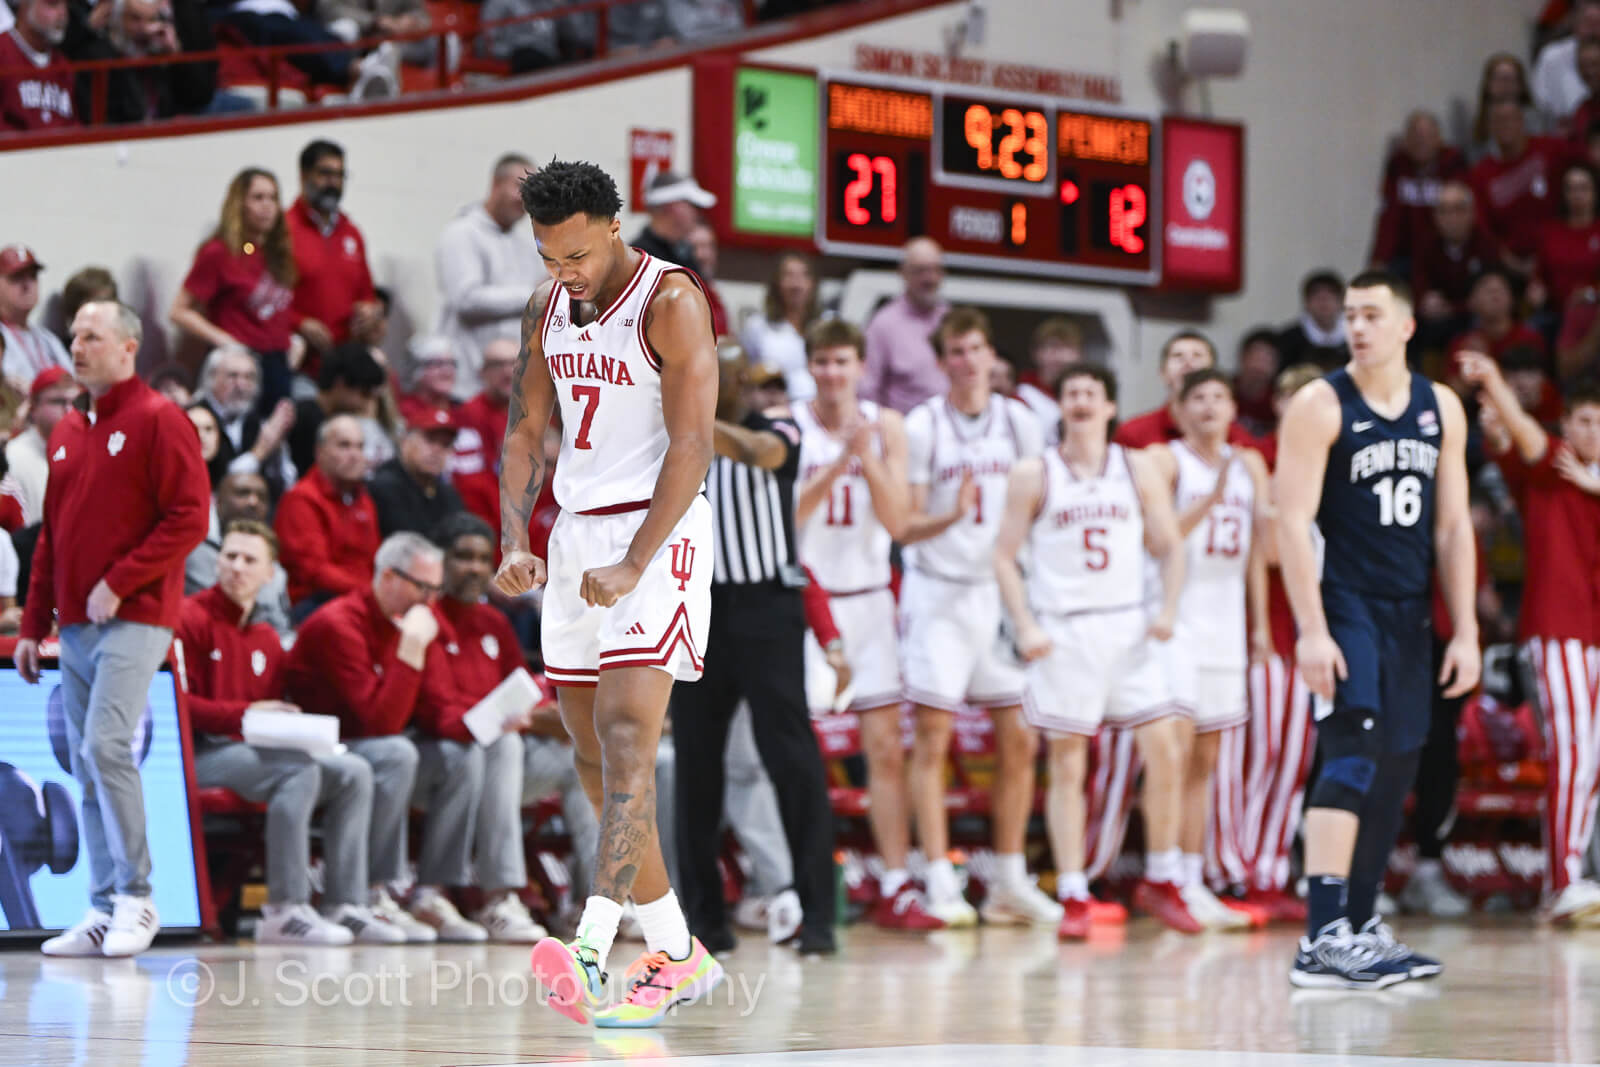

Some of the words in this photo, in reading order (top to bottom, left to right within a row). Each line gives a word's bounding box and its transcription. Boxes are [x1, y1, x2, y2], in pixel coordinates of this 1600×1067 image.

[844, 153, 897, 225] 27
[1011, 202, 1027, 245] 1
[552, 315, 564, 328] 76
[545, 352, 635, 385] INDIANA
[571, 384, 600, 450] 7
[1350, 439, 1396, 484] PENN
[1372, 475, 1422, 527] 16
[1083, 527, 1109, 571] 5
[1205, 514, 1241, 557] 13
